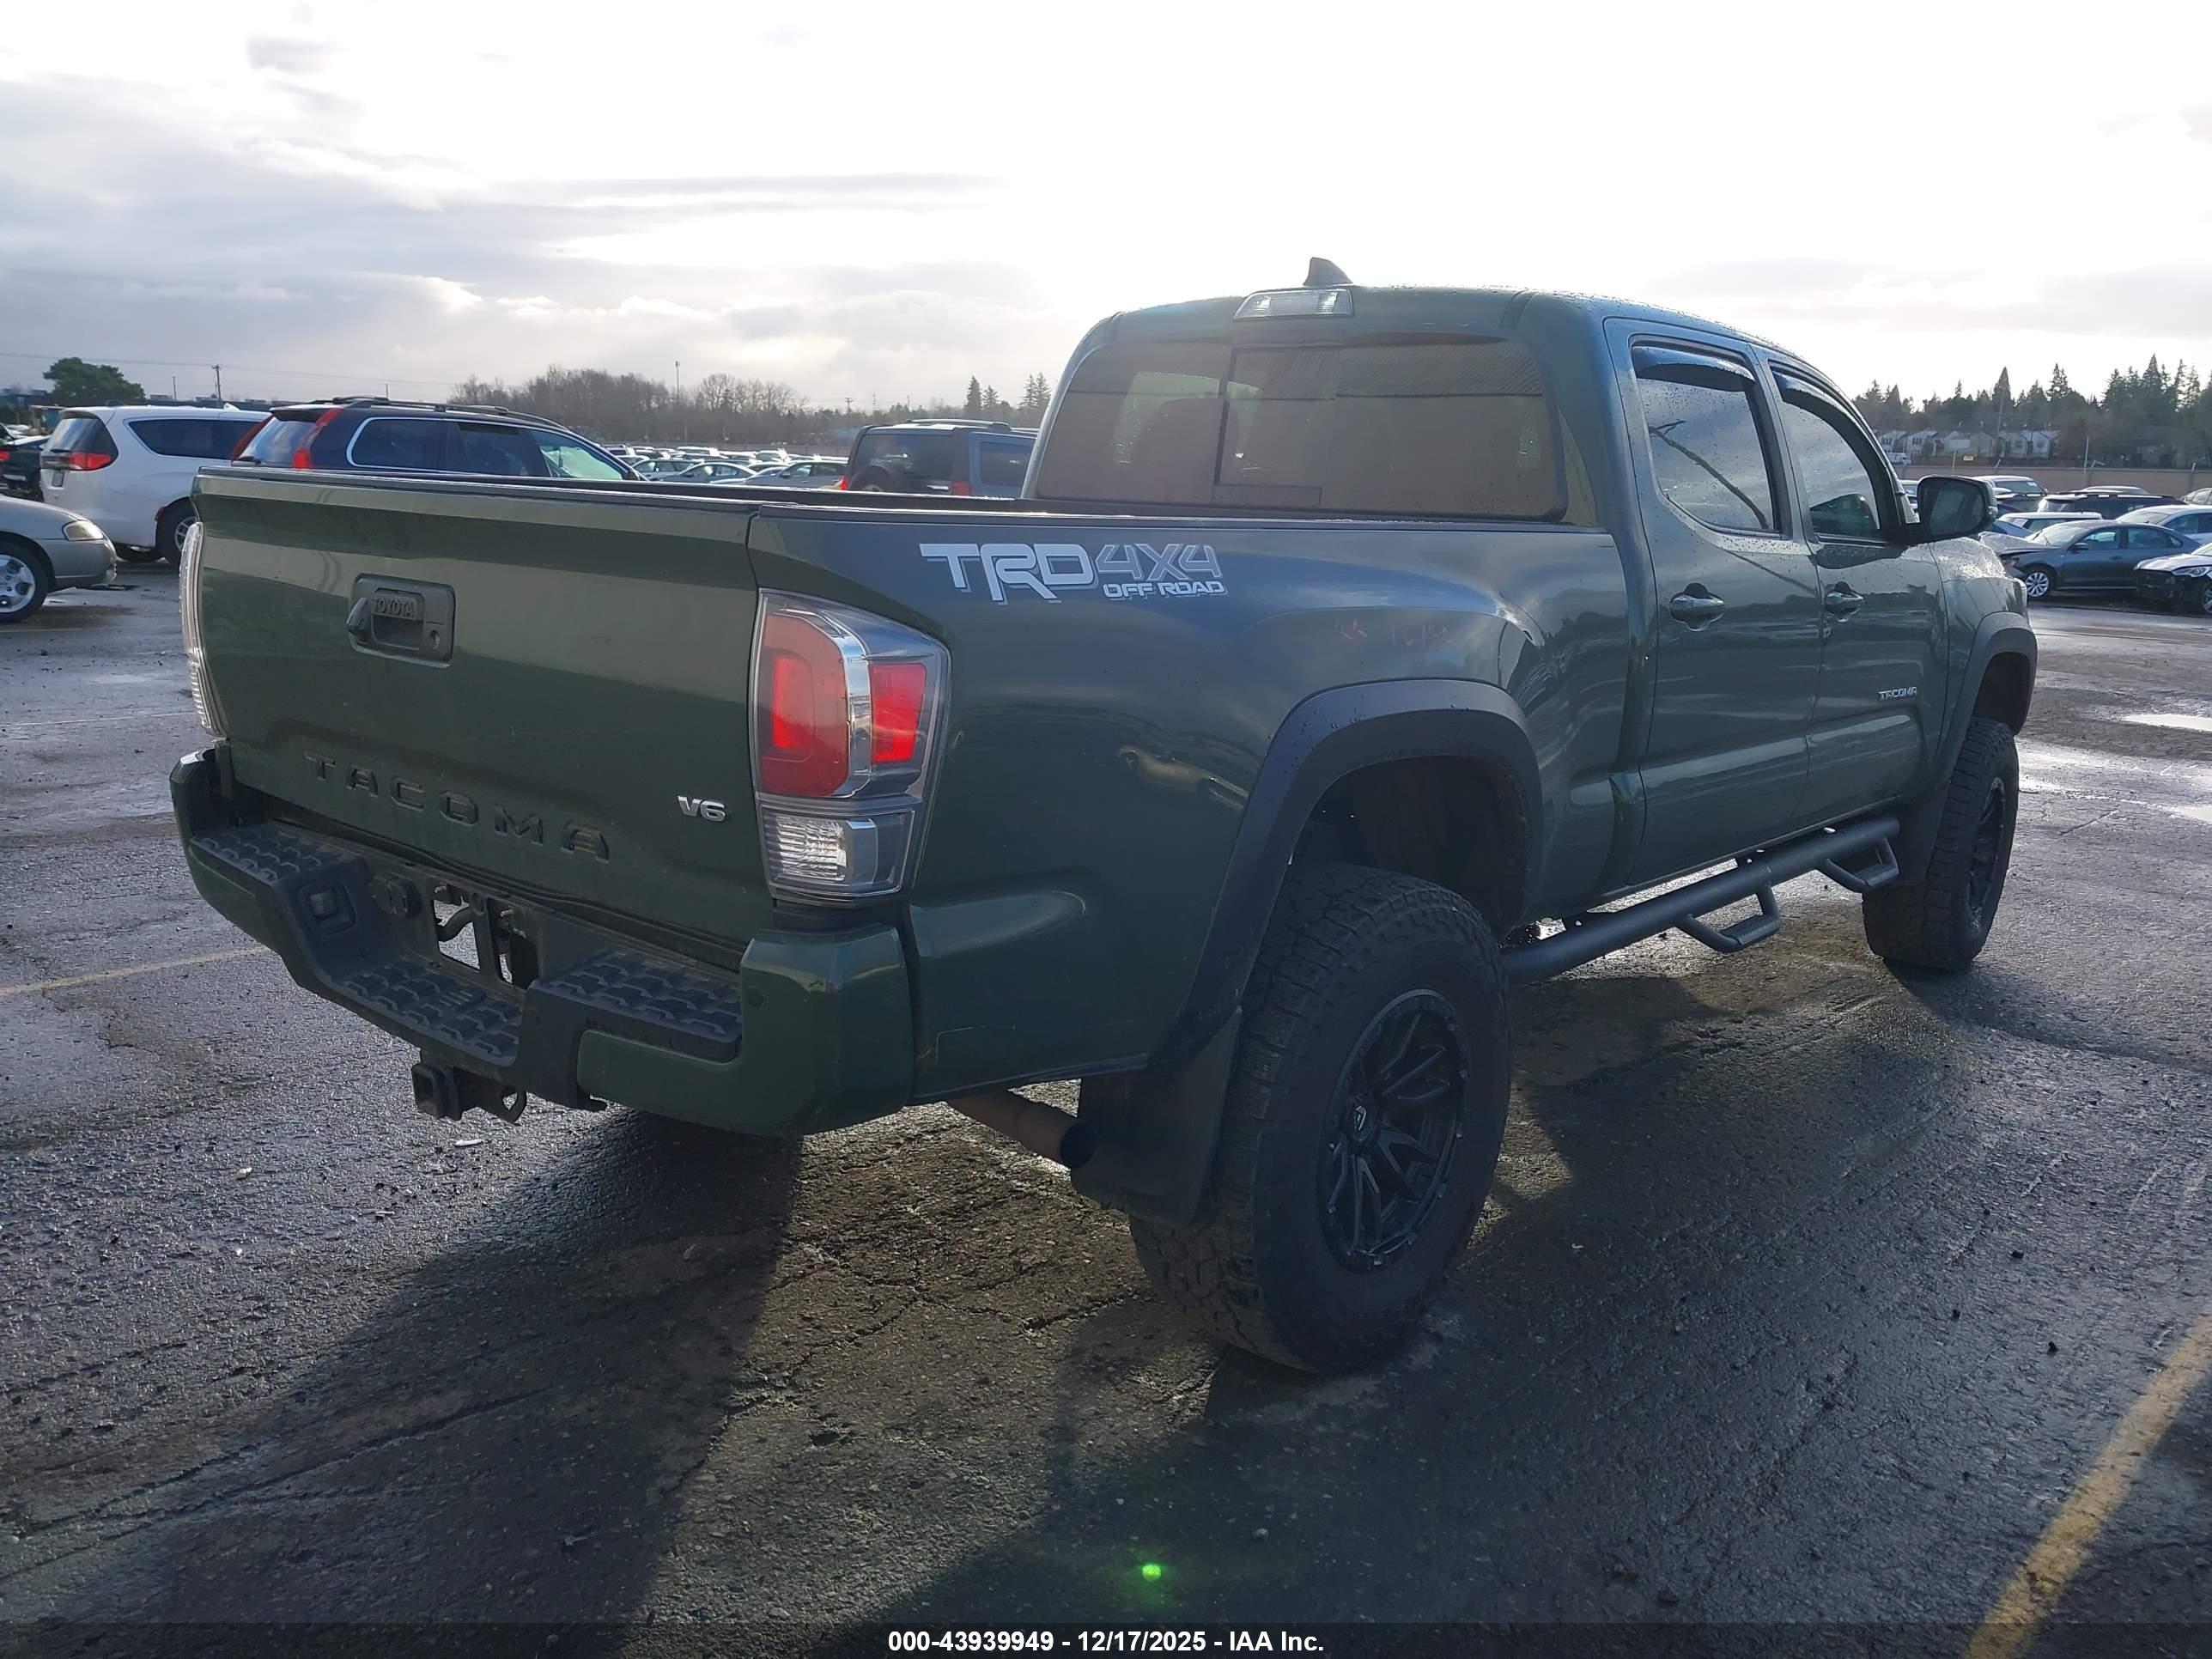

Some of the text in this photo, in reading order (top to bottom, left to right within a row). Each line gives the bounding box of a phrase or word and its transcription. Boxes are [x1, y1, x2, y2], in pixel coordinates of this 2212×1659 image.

[919, 543, 1098, 605] TRD
[1103, 580, 1227, 600] OFF ROAD
[372, 597, 416, 617] TOYOTA
[1878, 686, 1917, 701] TACOMA
[303, 750, 611, 864] TACOMA
[678, 795, 728, 822] V6
